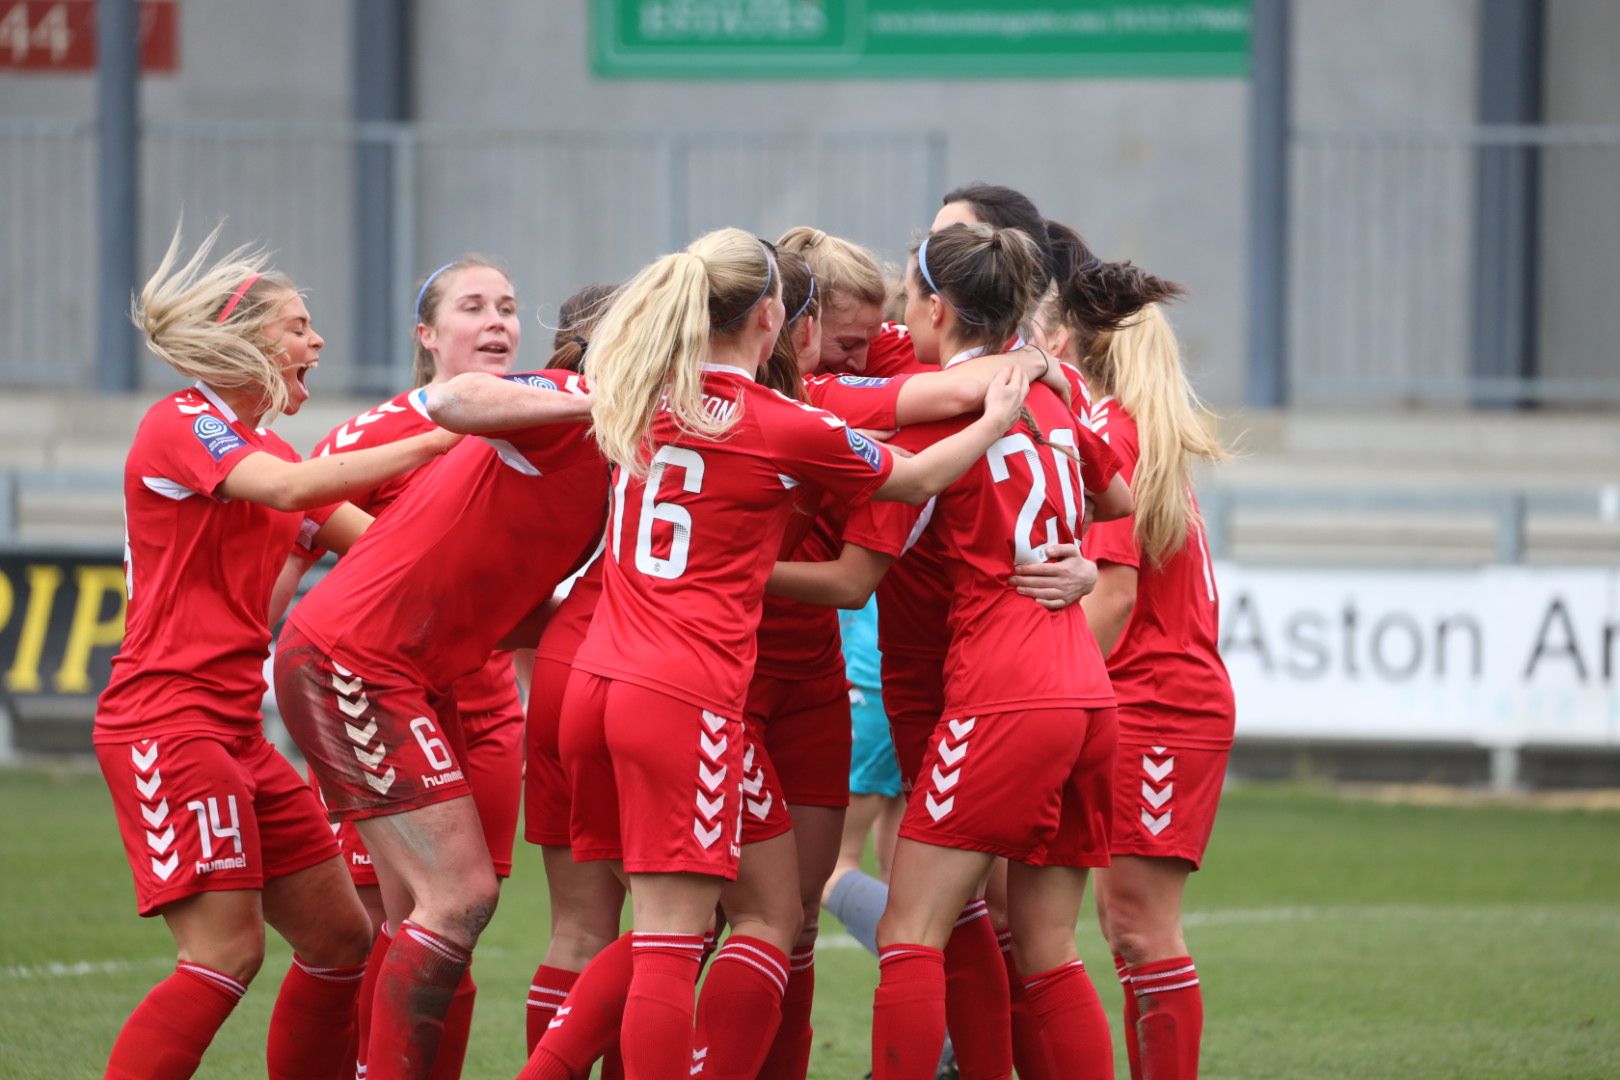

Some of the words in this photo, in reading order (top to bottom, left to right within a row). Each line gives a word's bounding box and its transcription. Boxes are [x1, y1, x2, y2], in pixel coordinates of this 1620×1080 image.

[0, 564, 128, 693] IP
[1218, 592, 1485, 682] Aston
[409, 716, 453, 771] 6
[187, 794, 243, 859] 14
[195, 852, 247, 875] hummel
